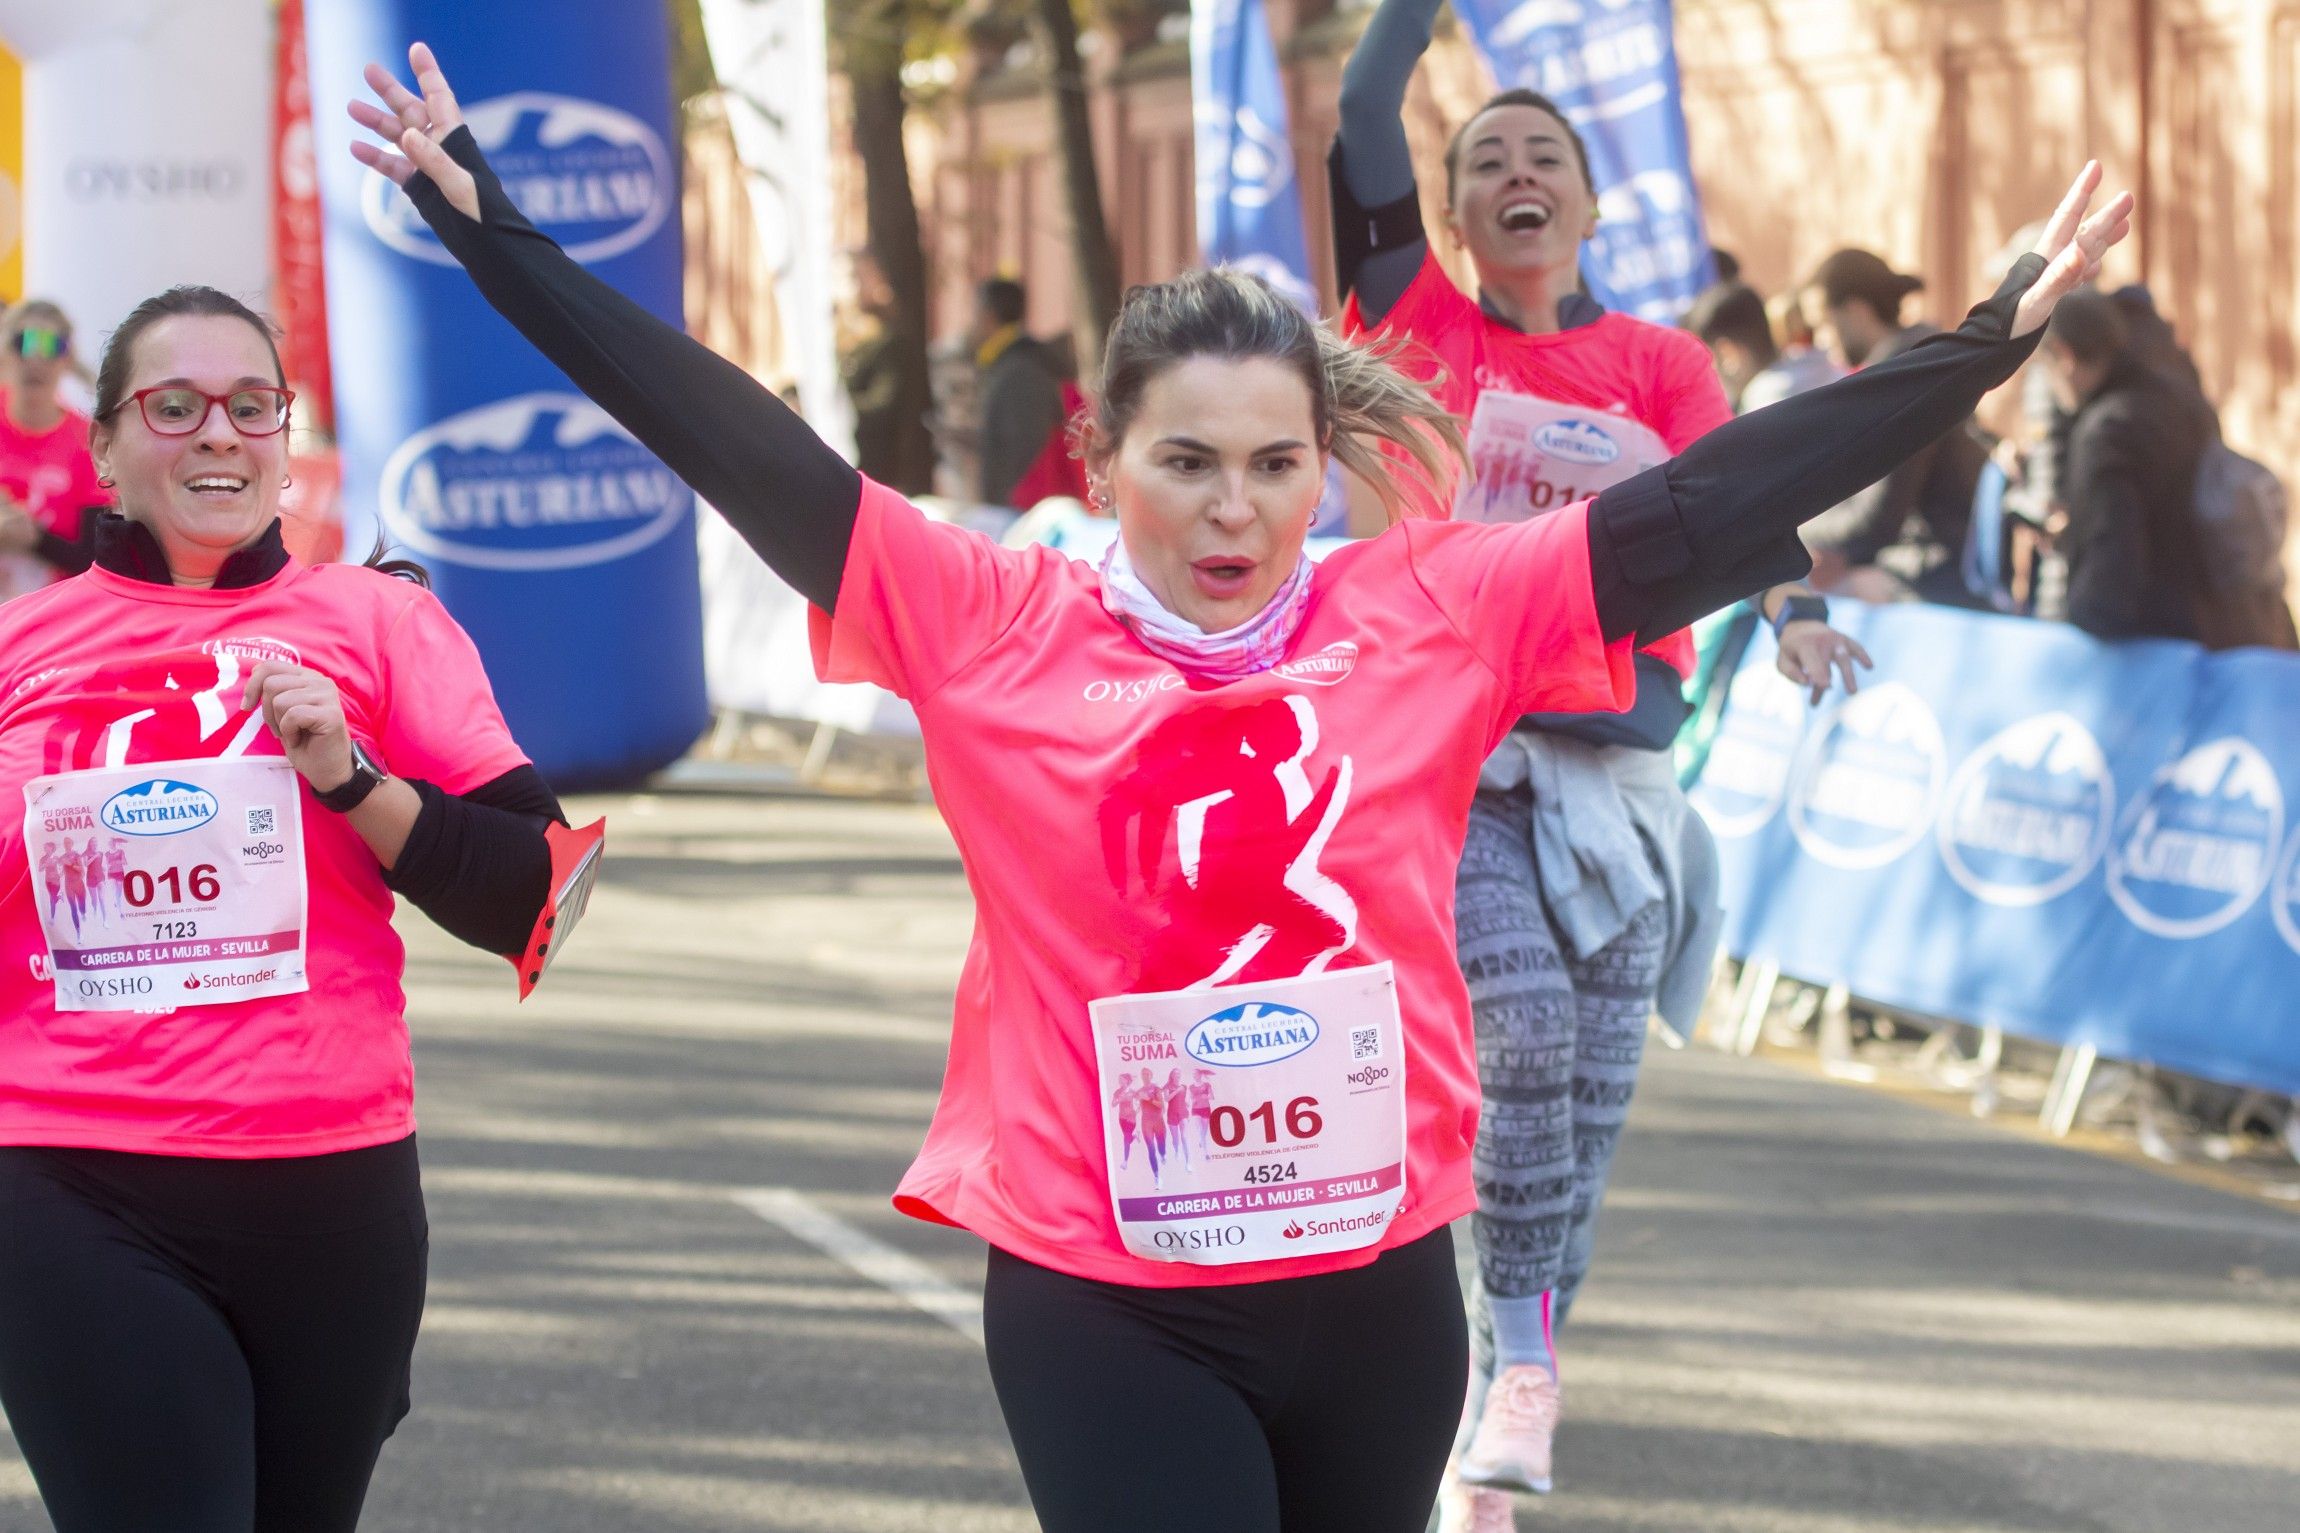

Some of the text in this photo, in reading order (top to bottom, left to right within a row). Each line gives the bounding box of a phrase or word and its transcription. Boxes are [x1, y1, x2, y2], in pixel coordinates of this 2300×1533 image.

[1530, 481, 1600, 508] 01
[42, 806, 93, 818] TU DORSAL
[110, 802, 211, 825] ASTURIANA
[44, 815, 95, 833] SUMA
[123, 864, 221, 907] 016
[152, 921, 197, 940] 7123
[80, 940, 269, 967] CARRERA DE LA MUJER SEVILLA
[79, 976, 153, 997] OYSHO
[203, 968, 277, 988] Santander
[1117, 1032, 1176, 1044] TU DORSAL
[1196, 1027, 1310, 1055] ASTURIANA
[1121, 1043, 1178, 1062] SUMA
[1209, 1096, 1323, 1148] 016
[1246, 1148, 1281, 1157] VIOLENCIA
[1243, 1161, 1298, 1185] 4524
[1156, 1176, 1379, 1216] CARRERA DE LA MUJER SEVILLA
[1306, 1210, 1386, 1237] Santander
[1153, 1225, 1246, 1250] OYSHO
